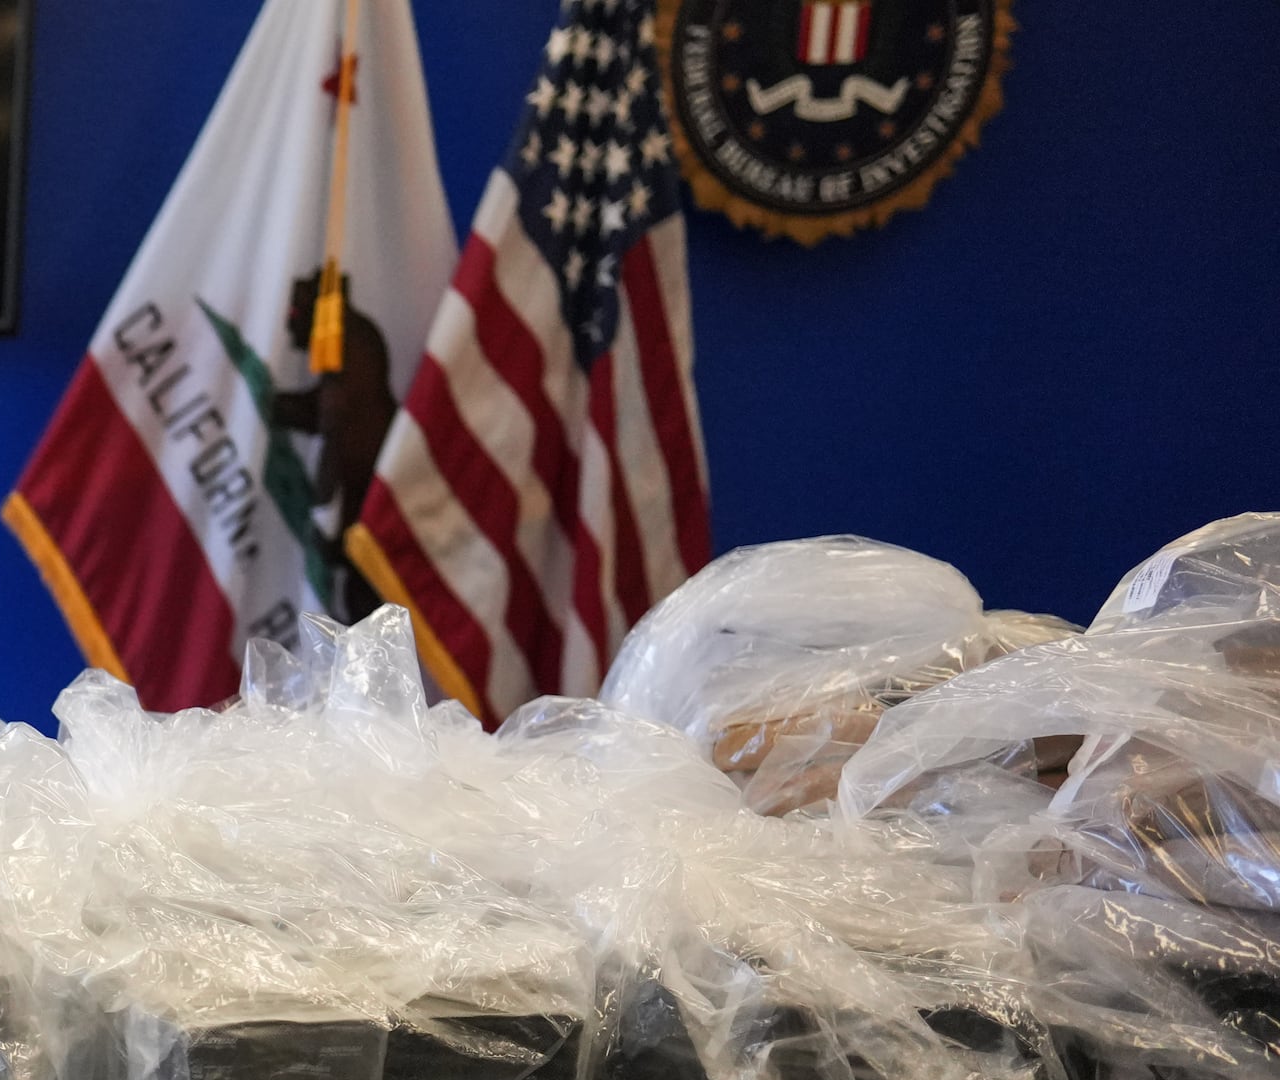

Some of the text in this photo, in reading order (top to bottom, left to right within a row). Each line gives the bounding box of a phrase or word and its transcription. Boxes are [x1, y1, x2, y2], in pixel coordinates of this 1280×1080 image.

[715, 138, 815, 202] BUREAU
[819, 171, 855, 202] OF
[859, 12, 983, 193] INVESTIGATION
